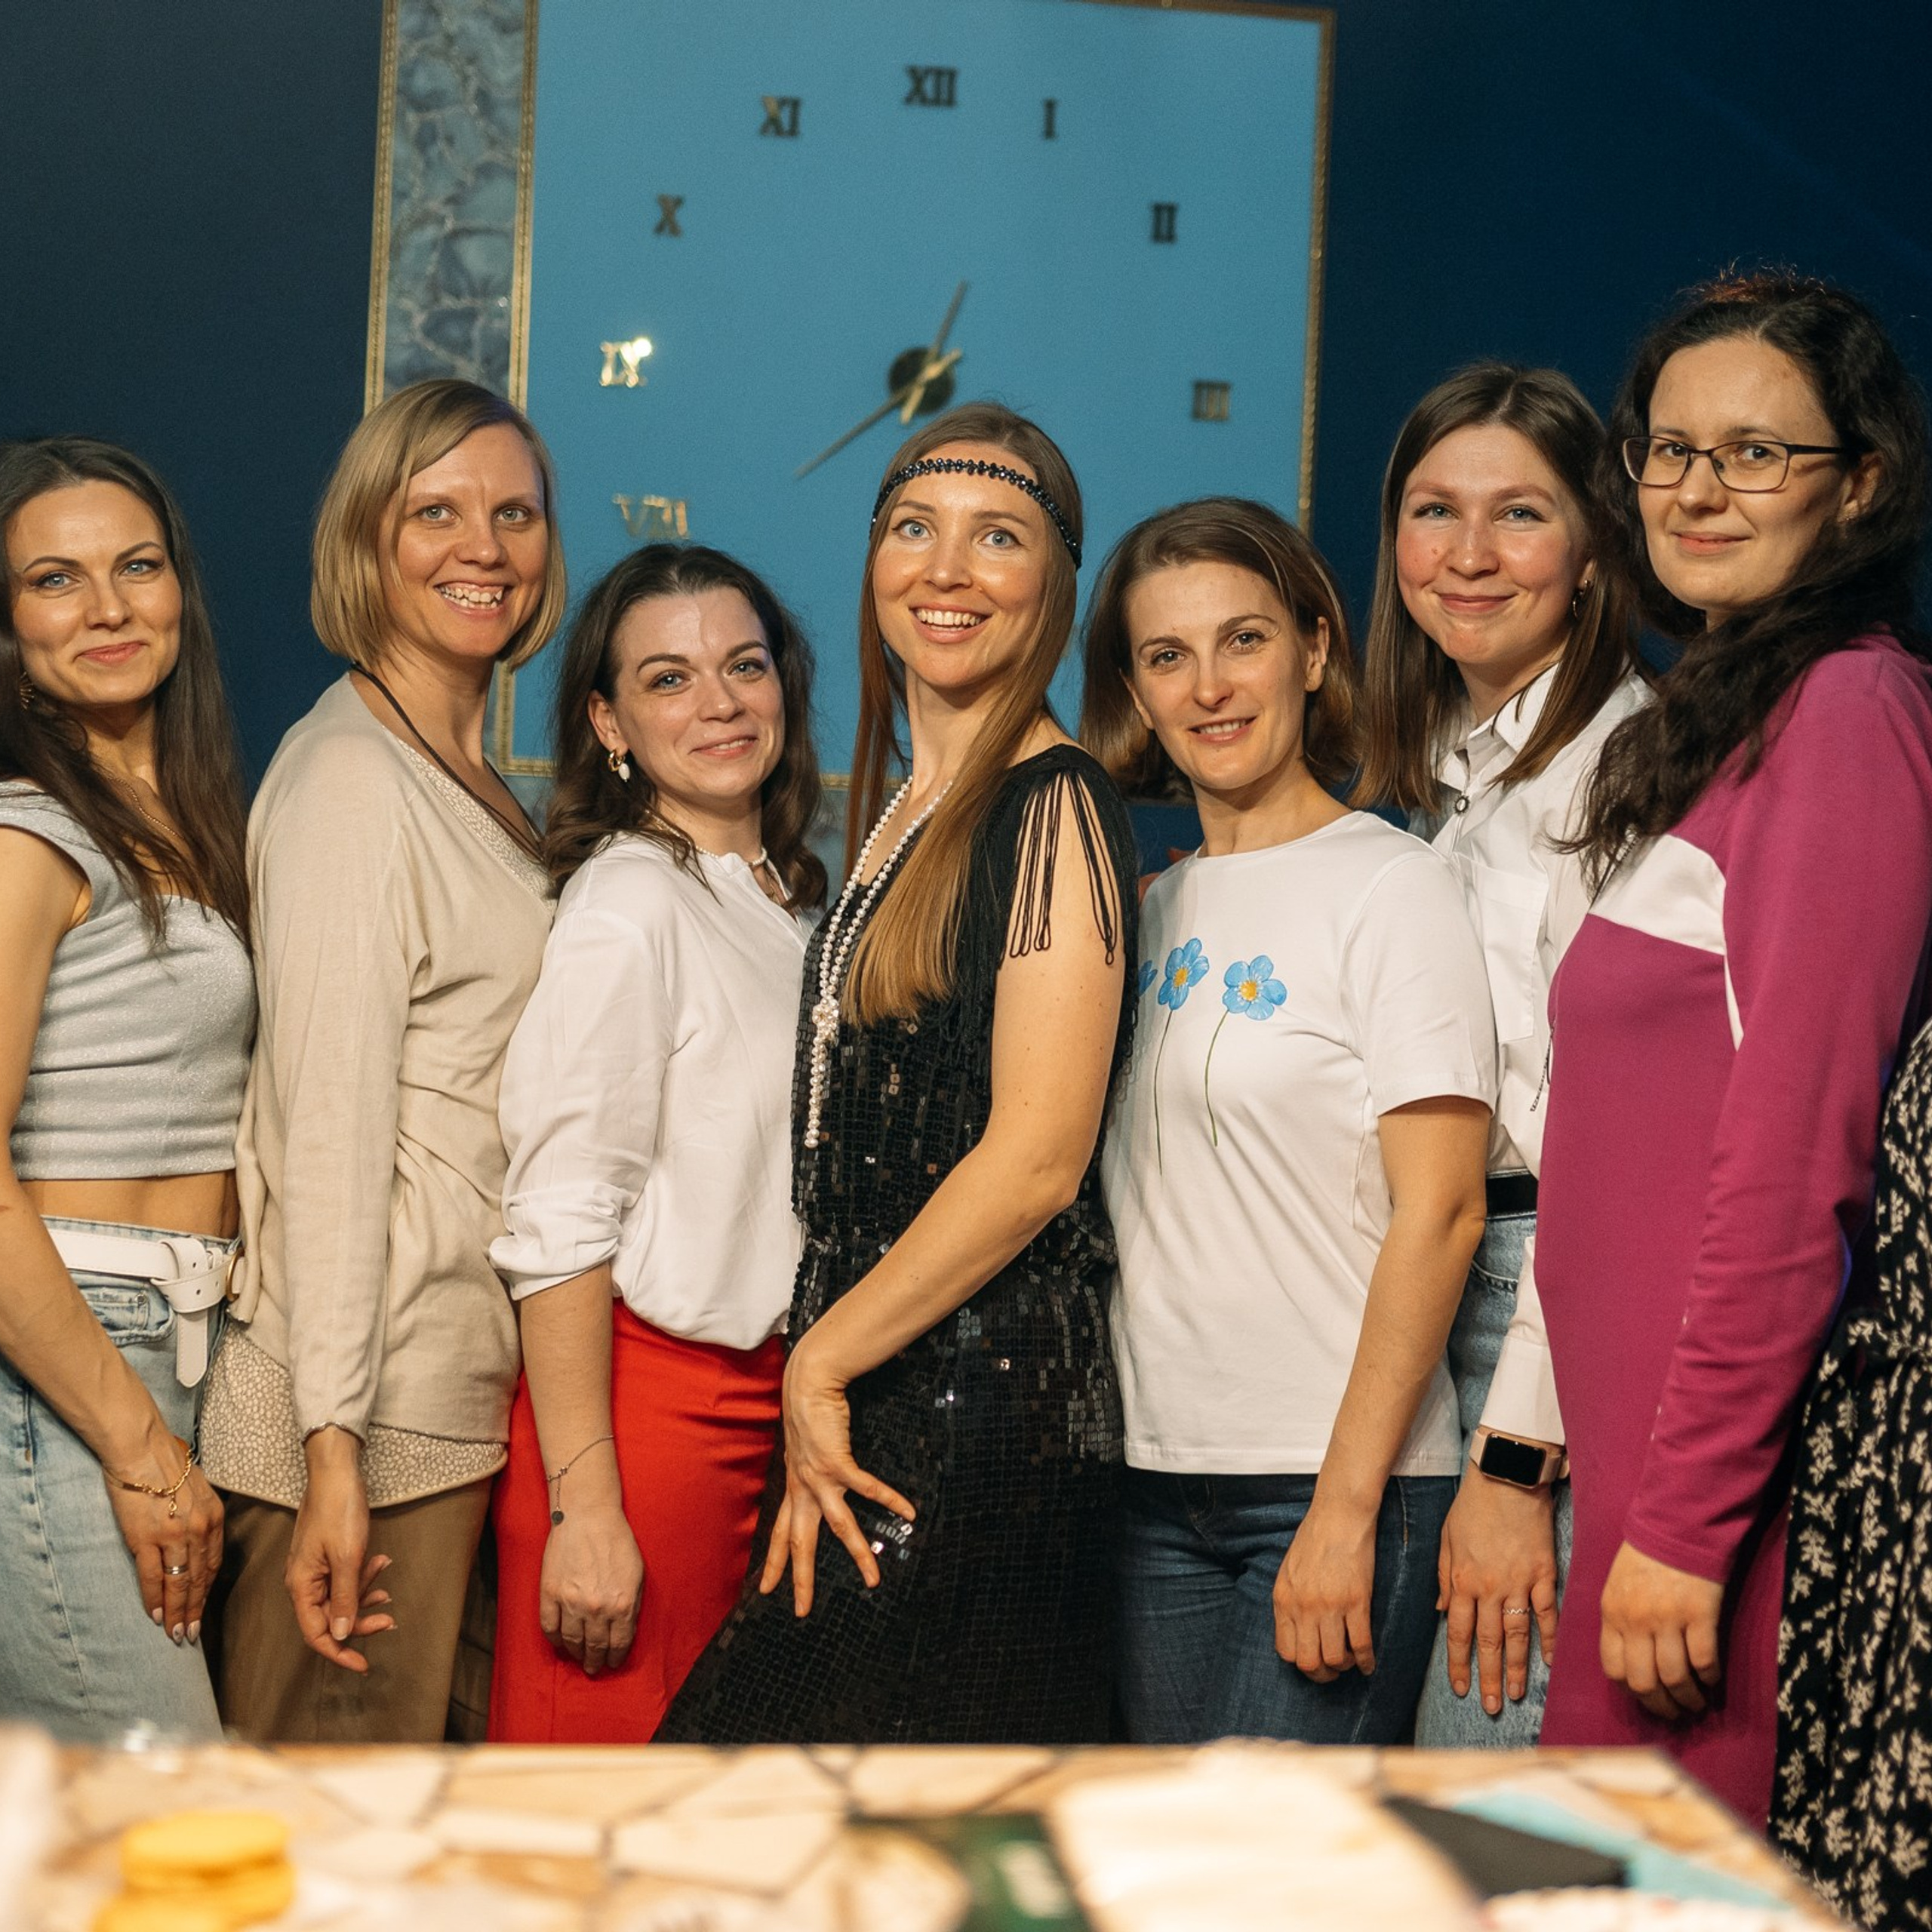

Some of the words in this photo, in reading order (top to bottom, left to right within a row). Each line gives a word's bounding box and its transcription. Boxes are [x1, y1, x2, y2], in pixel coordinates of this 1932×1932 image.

[904, 66, 957, 108] XII
[760, 97, 801, 137] XI
[1043, 99, 1057, 140] I
[654, 194, 684, 238] X
[1151, 202, 1177, 244] II
[599, 337, 653, 388] IX
[1192, 380, 1231, 421] III
